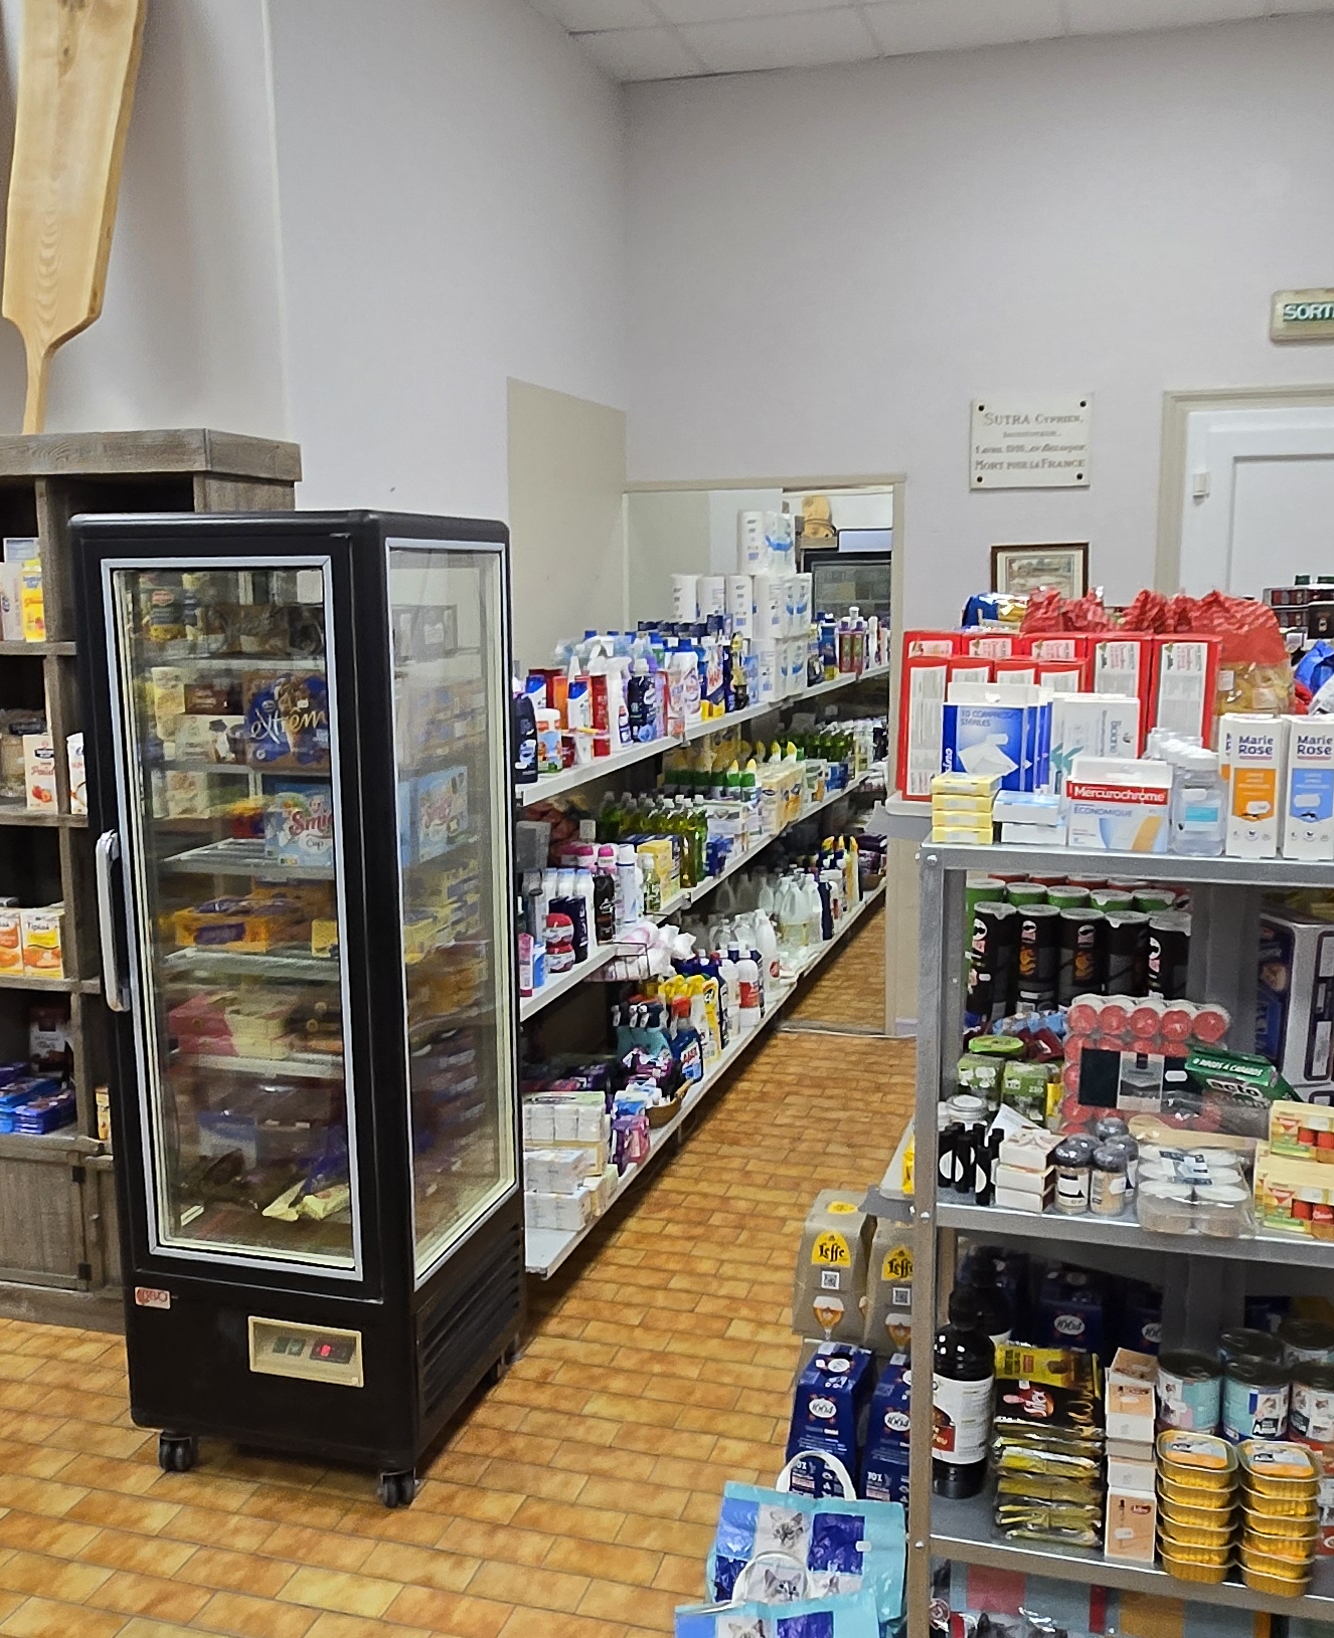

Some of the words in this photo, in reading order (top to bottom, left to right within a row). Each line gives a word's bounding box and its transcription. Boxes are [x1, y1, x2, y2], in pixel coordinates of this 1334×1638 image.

[983, 412, 1030, 426] SUTRA
[975, 460, 1004, 471] MORT
[1041, 458, 1086, 468] FRANCE
[1239, 735, 1274, 745] Marie
[1297, 735, 1333, 745] Marie
[1238, 744, 1273, 755] Rose
[1297, 744, 1332, 755] Rose
[1074, 785, 1165, 803] Mercurochrome
[819, 1243, 845, 1262] Leffe
